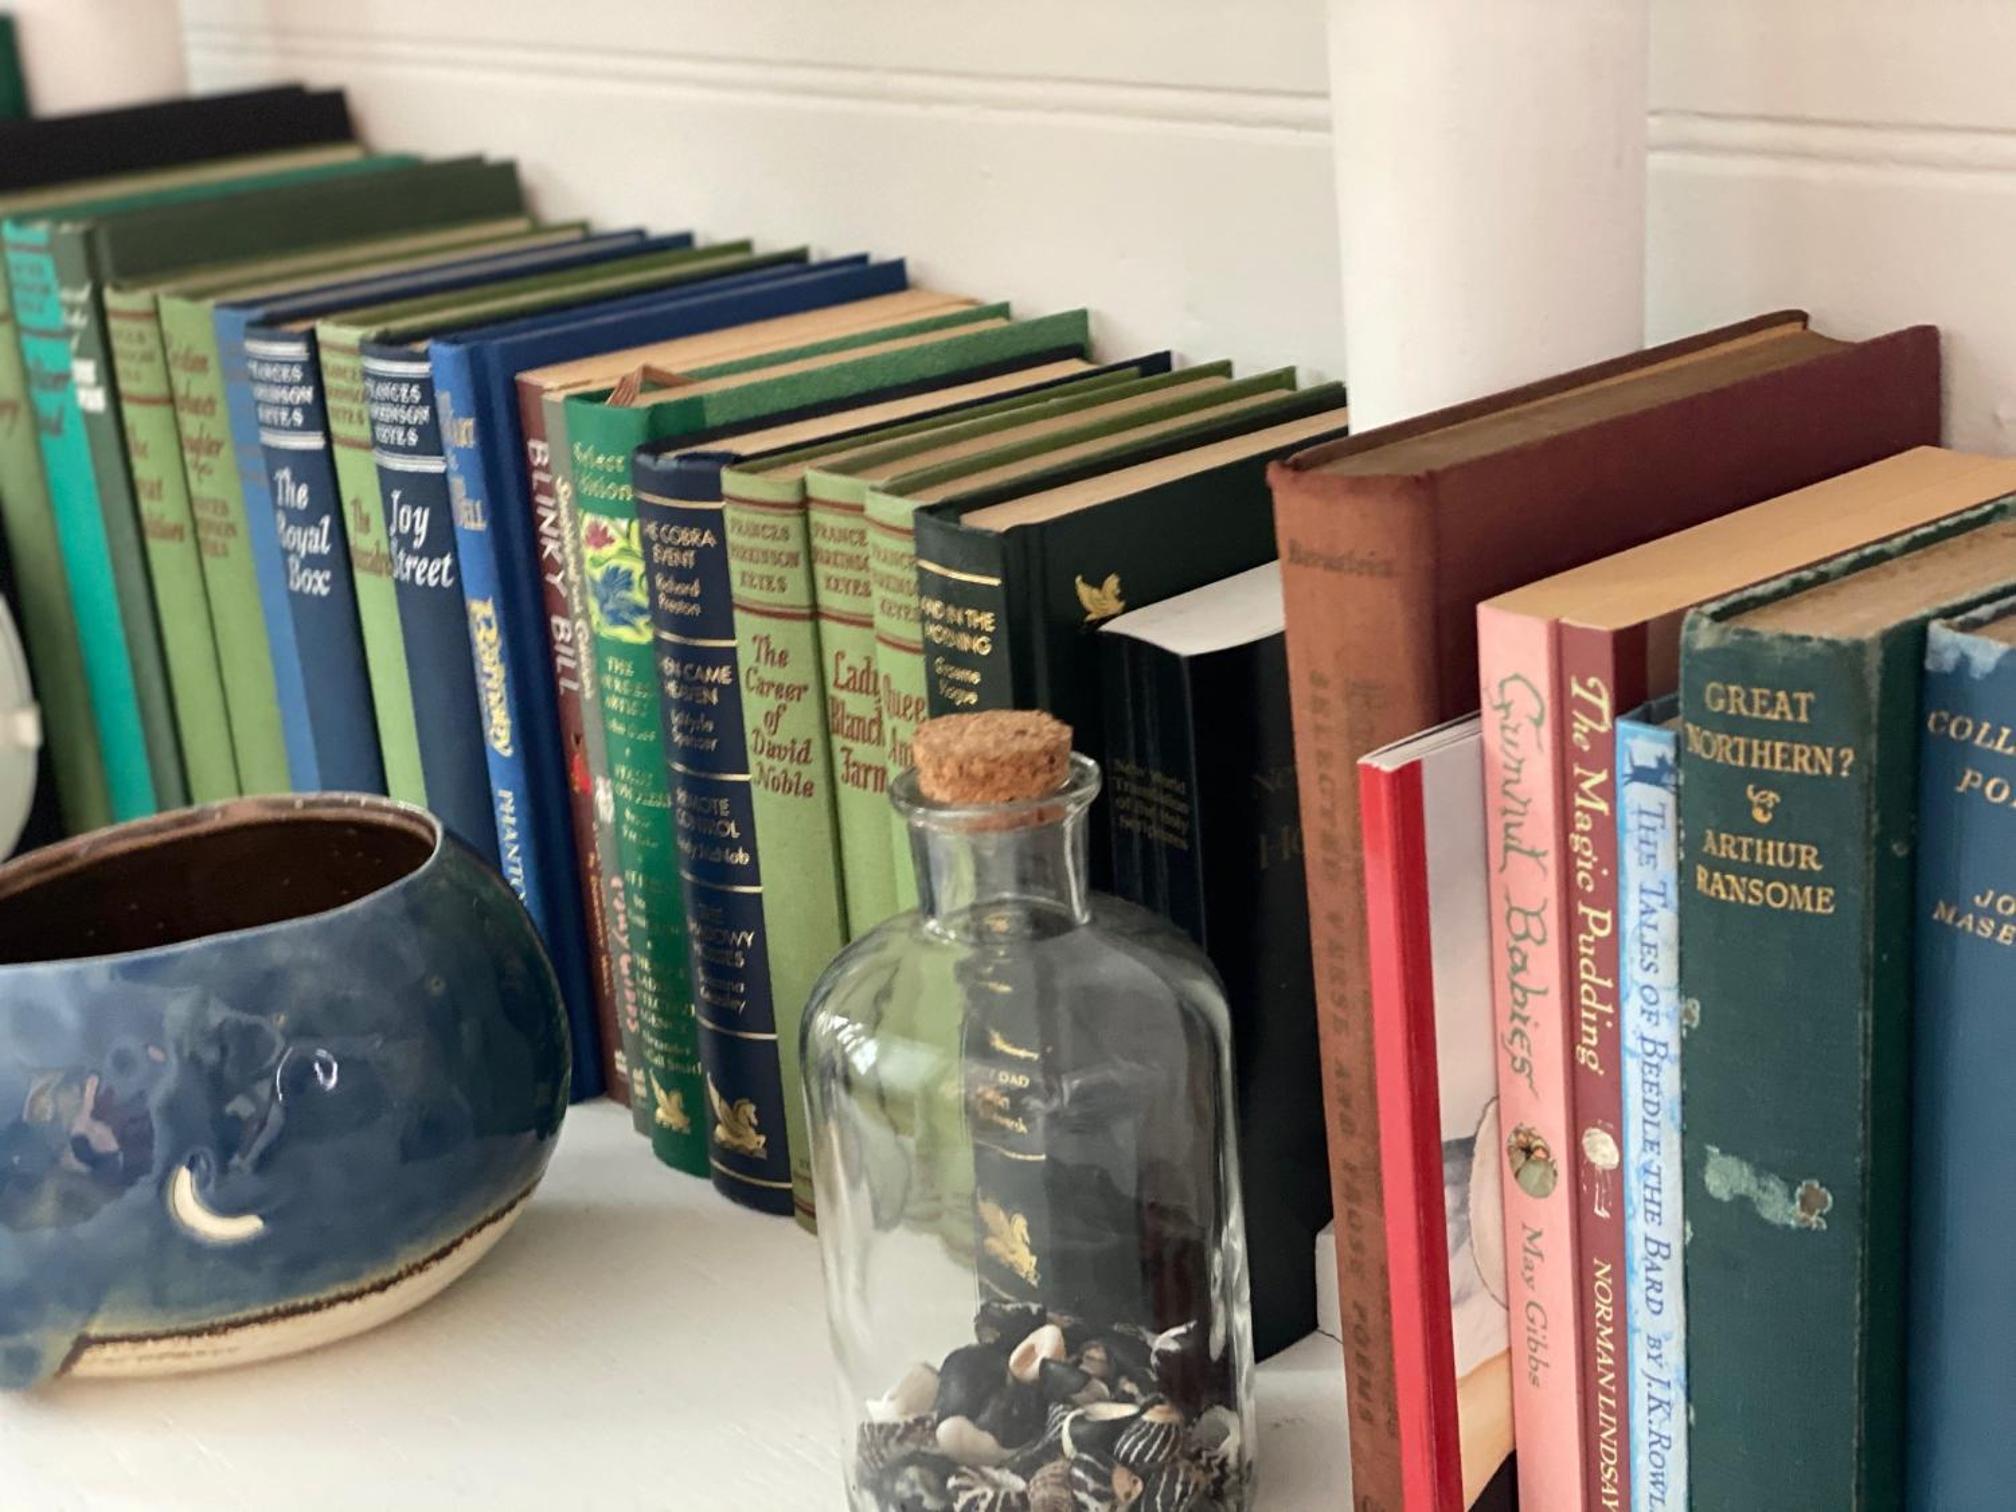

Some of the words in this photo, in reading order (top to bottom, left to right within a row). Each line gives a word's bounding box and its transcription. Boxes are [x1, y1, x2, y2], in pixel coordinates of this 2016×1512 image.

[274, 466, 308, 510] The
[276, 511, 332, 559] Royal
[390, 489, 429, 549] Joy
[659, 527, 717, 549] COBRA
[288, 553, 331, 596] Box
[389, 539, 455, 587] Street
[527, 438, 568, 597] BLINKY
[551, 615, 580, 696] BILL
[683, 662, 733, 687] CAME
[752, 633, 789, 670] The
[744, 667, 808, 703] Career
[1705, 682, 1816, 724] GREAT
[763, 703, 788, 737] of
[1570, 675, 1613, 753] The
[1927, 709, 2016, 756] COLL
[751, 728, 813, 766] David
[1685, 722, 1855, 778] NORTHERN?
[755, 761, 815, 799] Noble
[1498, 672, 1547, 877] Gumnut
[1955, 767, 2016, 808] PO
[1569, 762, 1611, 892] Magic
[1635, 802, 1668, 867] THE
[1703, 829, 1824, 872] ARTHUR
[1696, 864, 1836, 915] RANSOME
[1973, 889, 2016, 917] JO
[1637, 874, 1668, 975] TALES
[1932, 899, 2016, 946] MASE
[1503, 893, 1549, 1098] Babies
[1575, 906, 1614, 1076] Pudding
[1638, 982, 1663, 1029] OF
[1639, 1030, 1669, 1157] BEEDLE
[1641, 1160, 1666, 1227] THE
[1521, 1222, 1545, 1286] May
[1643, 1232, 1672, 1316] BARD
[1524, 1300, 1549, 1390] Gibbs
[1593, 1256, 1616, 1393] NORMAN
[1646, 1334, 1665, 1368] BY
[1598, 1393, 1620, 1512] LINDSAY
